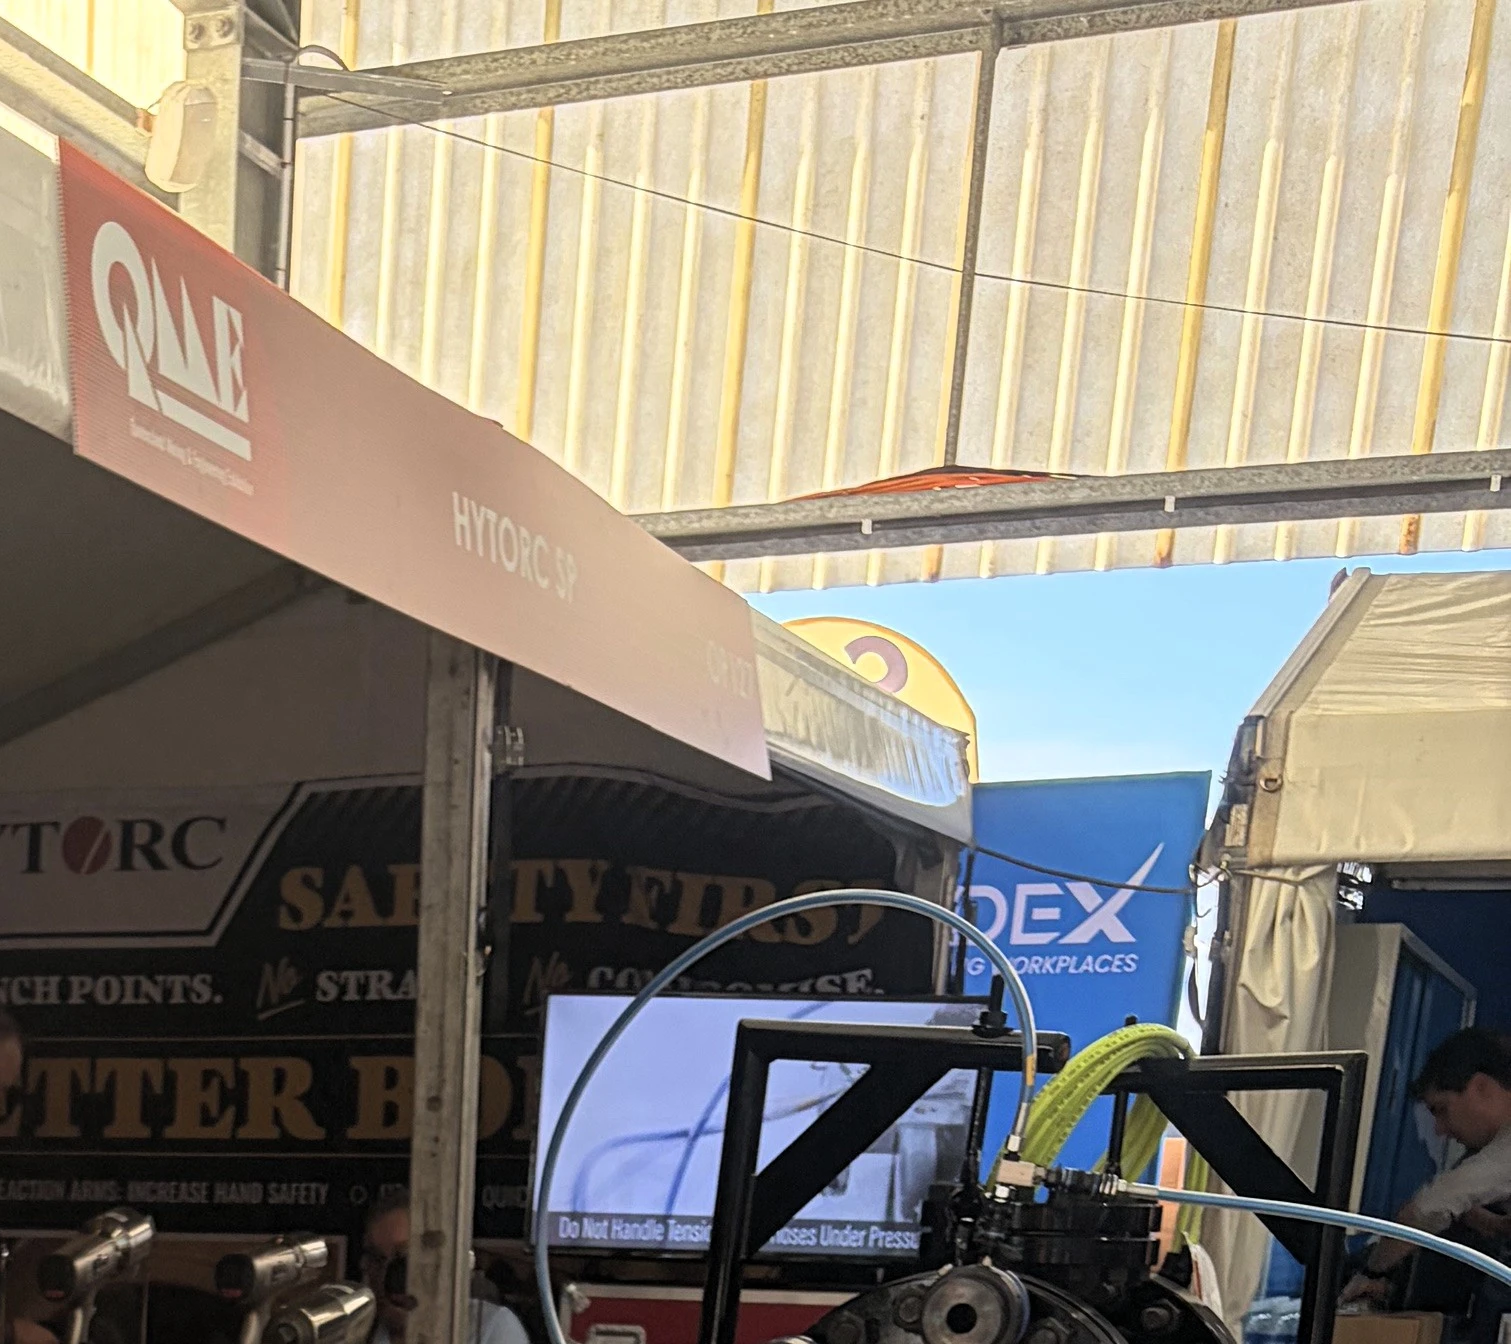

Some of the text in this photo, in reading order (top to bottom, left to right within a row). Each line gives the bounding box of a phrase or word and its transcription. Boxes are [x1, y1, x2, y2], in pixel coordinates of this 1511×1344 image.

[452, 491, 579, 603] HYTORC SP
[68, 973, 224, 1005] POINTS.
[316, 969, 419, 1003] STRA
[214, 1181, 264, 1205] HAND
[268, 1182, 330, 1205] SAFETY
[558, 1216, 580, 1239] Do
[582, 1217, 609, 1240] Not
[611, 1217, 665, 1241] Handle
[820, 1224, 866, 1248] Under
[868, 1225, 921, 1250] Pressu
